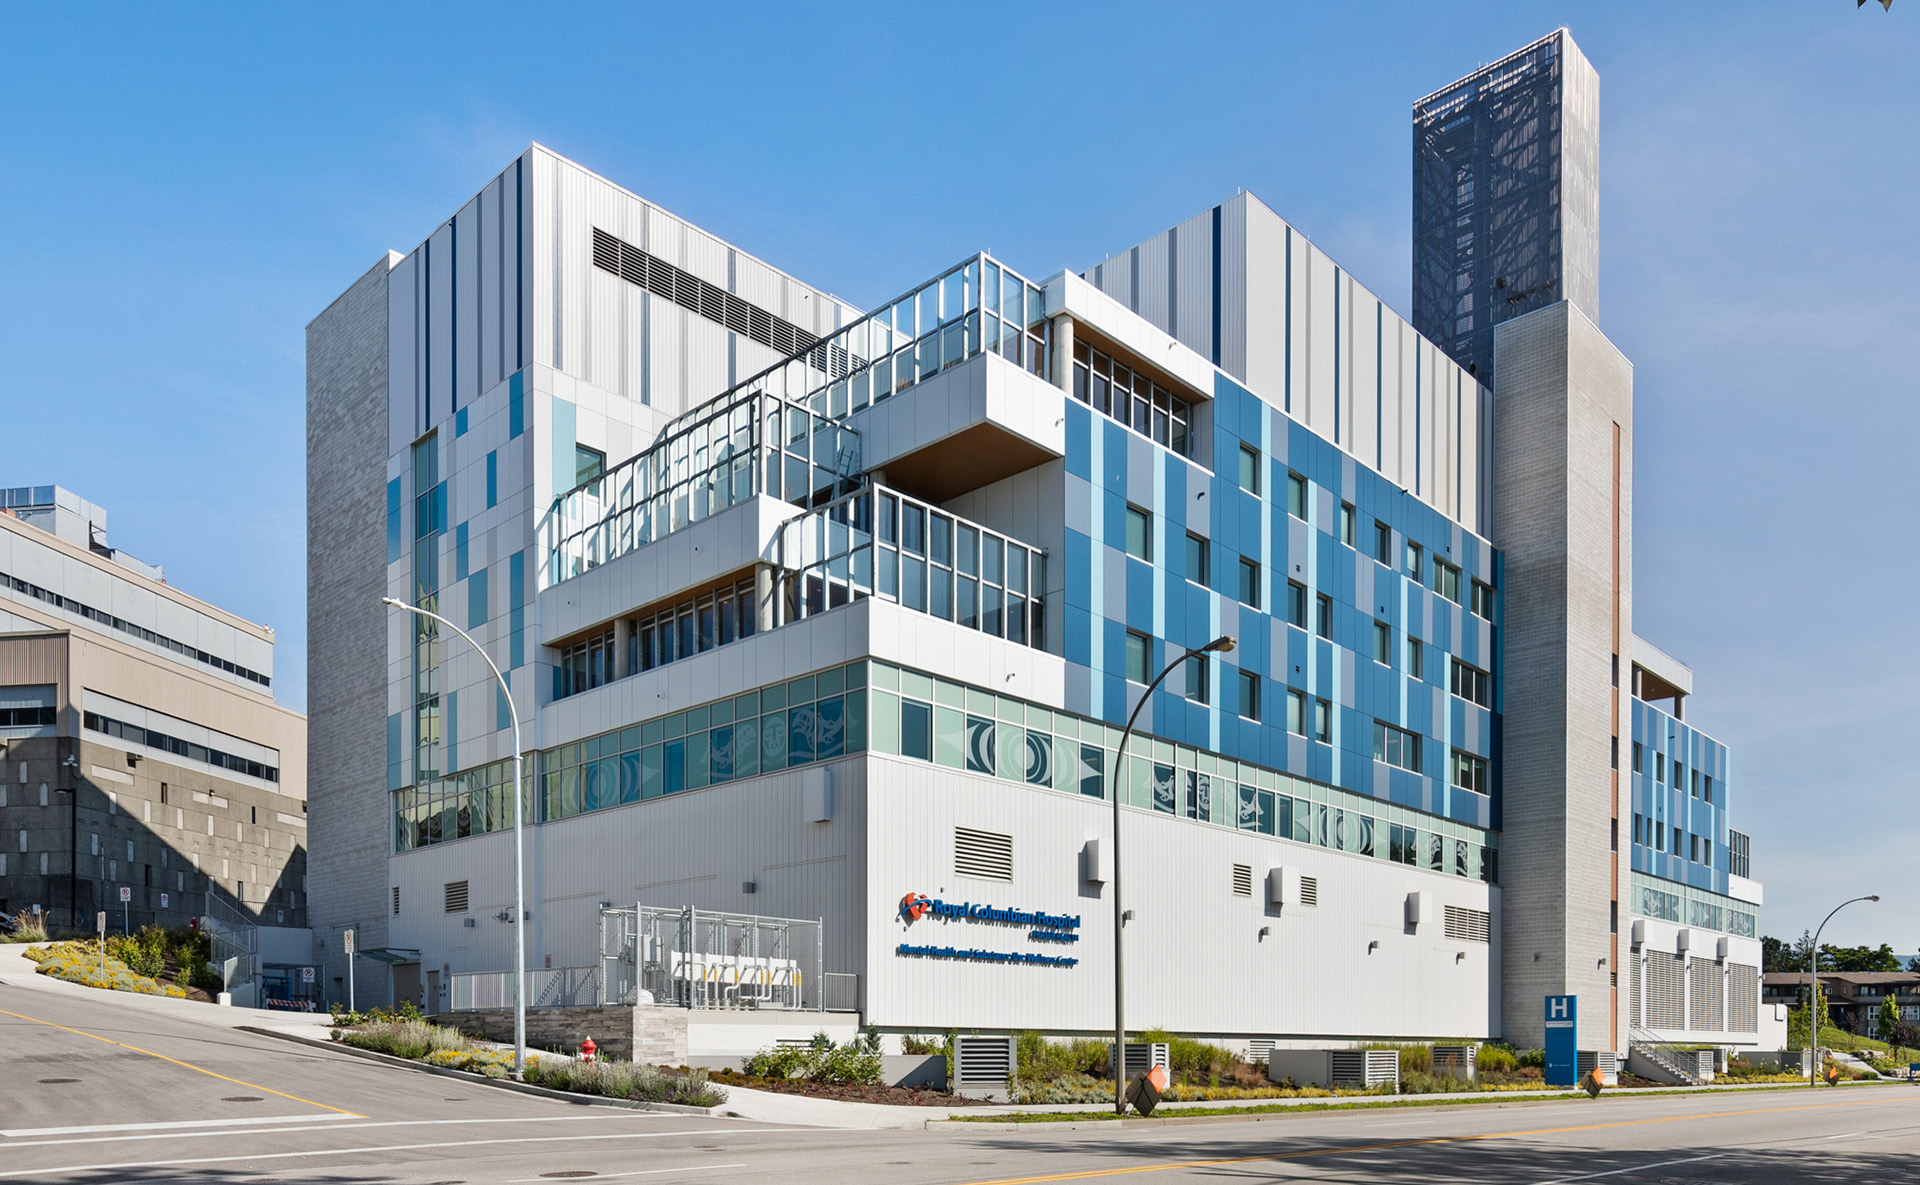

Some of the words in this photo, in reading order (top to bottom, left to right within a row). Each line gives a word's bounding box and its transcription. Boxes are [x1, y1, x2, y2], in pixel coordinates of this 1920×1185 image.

[932, 899, 969, 919] Royal
[970, 904, 1035, 924] Columbian
[1036, 911, 1081, 929] Hospital
[1032, 930, 1056, 940] FRASER
[900, 943, 929, 954] Mental
[930, 945, 956, 957] Health
[958, 948, 973, 958] and
[1551, 998, 1567, 1018] H
